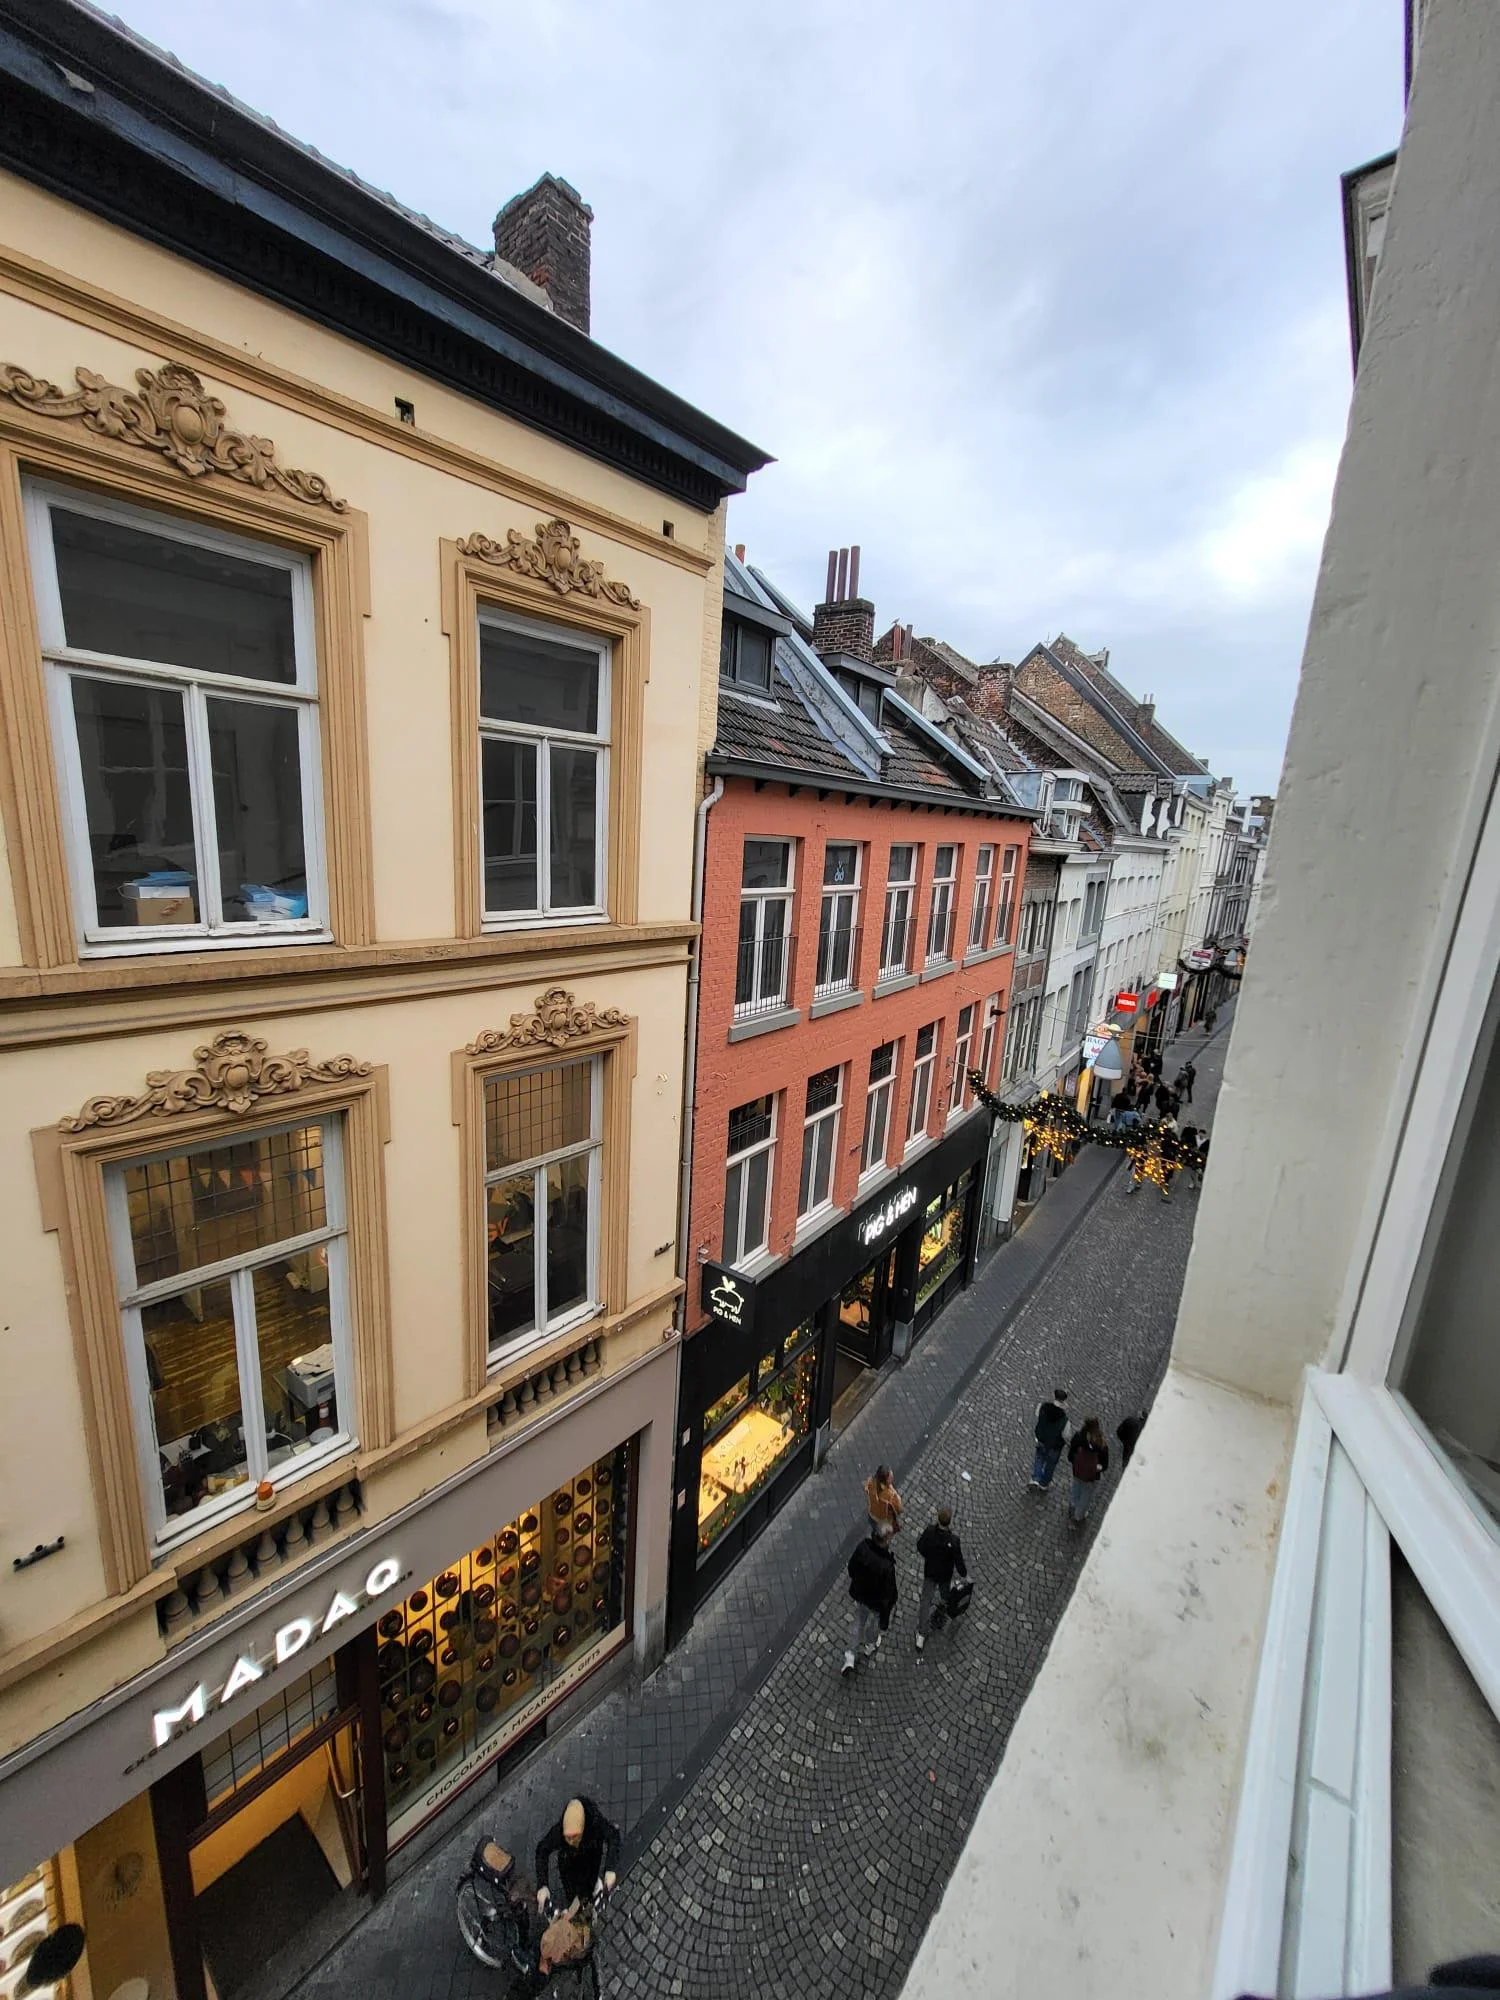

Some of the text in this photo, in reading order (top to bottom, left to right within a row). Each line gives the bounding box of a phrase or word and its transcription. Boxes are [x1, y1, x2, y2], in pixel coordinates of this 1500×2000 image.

[864, 1215, 885, 1246] PIG
[885, 1205, 895, 1227] &
[152, 1558, 401, 1748] MADAQ
[425, 1648, 601, 1807] CHOCOLATES MACARONS GIFTS
